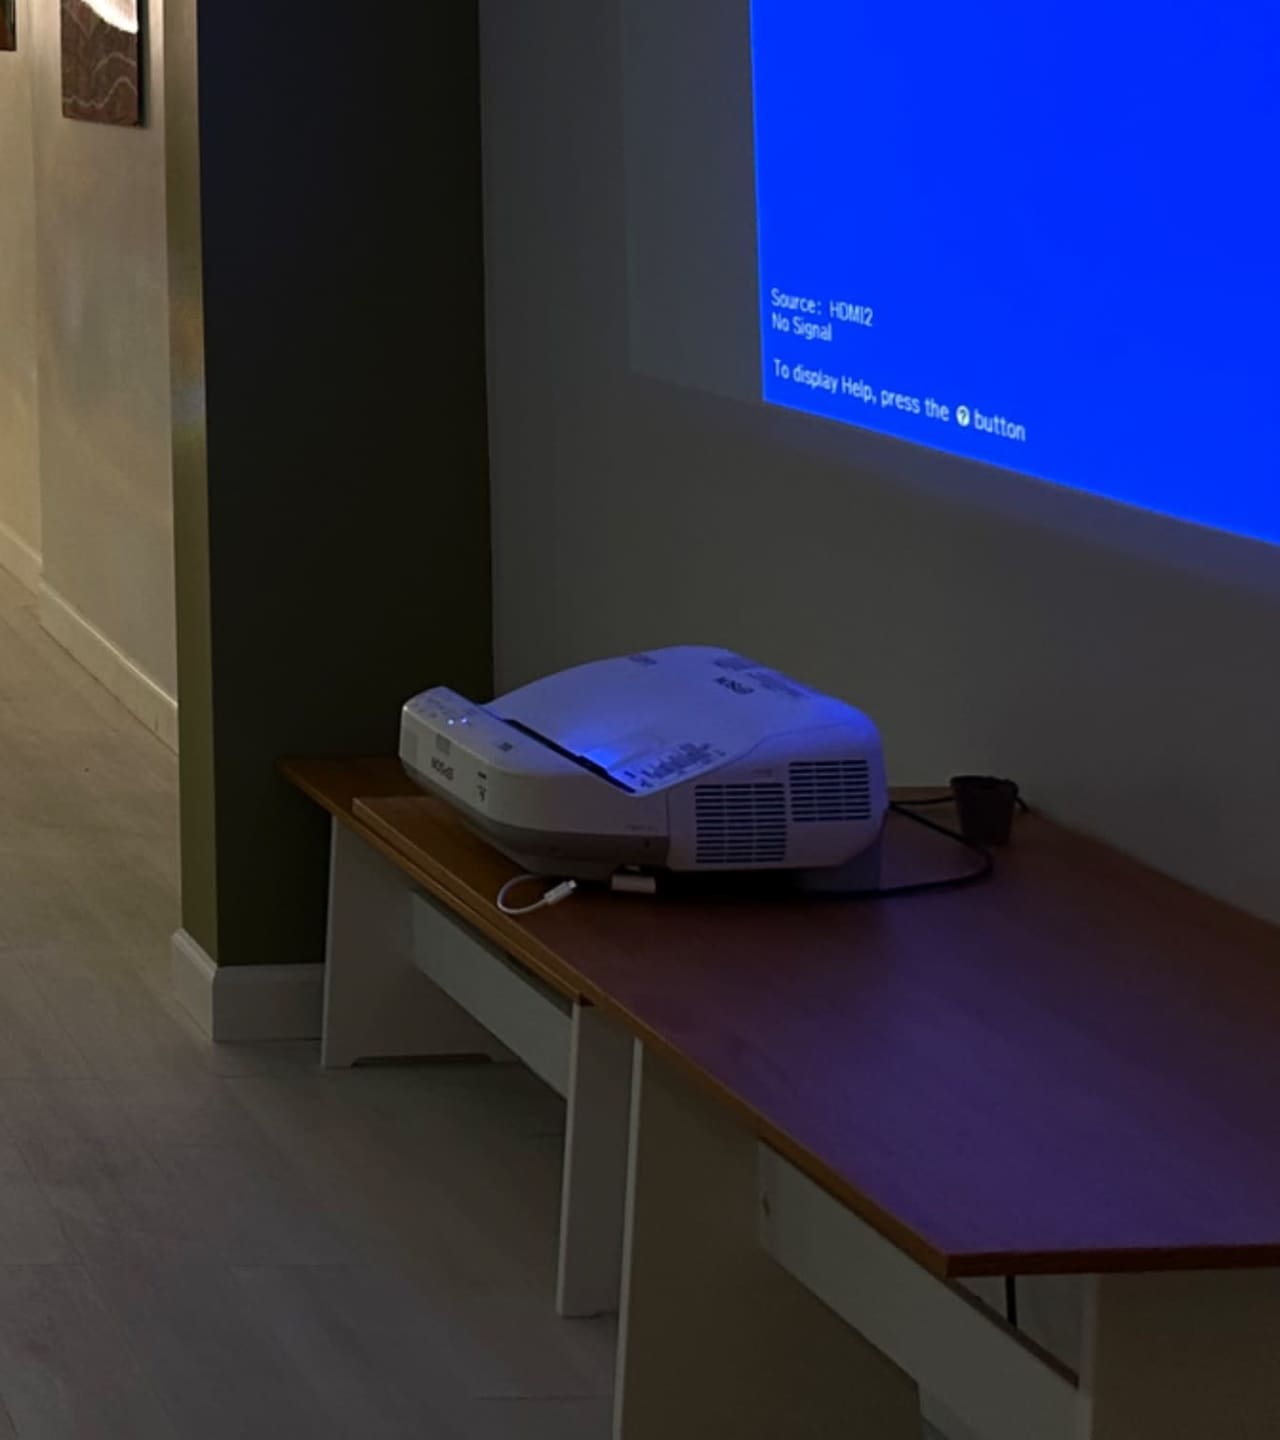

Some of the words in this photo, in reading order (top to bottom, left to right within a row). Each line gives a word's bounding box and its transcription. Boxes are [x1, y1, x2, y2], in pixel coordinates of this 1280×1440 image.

[771, 288, 822, 316] Source:
[829, 300, 874, 327] HDMI2
[772, 312, 790, 332] No
[793, 316, 833, 342] Signal
[773, 358, 790, 379] To
[793, 364, 838, 394] display
[842, 376, 877, 405] Help,
[881, 390, 921, 415] press
[925, 398, 950, 422] the
[974, 409, 1026, 442] button
